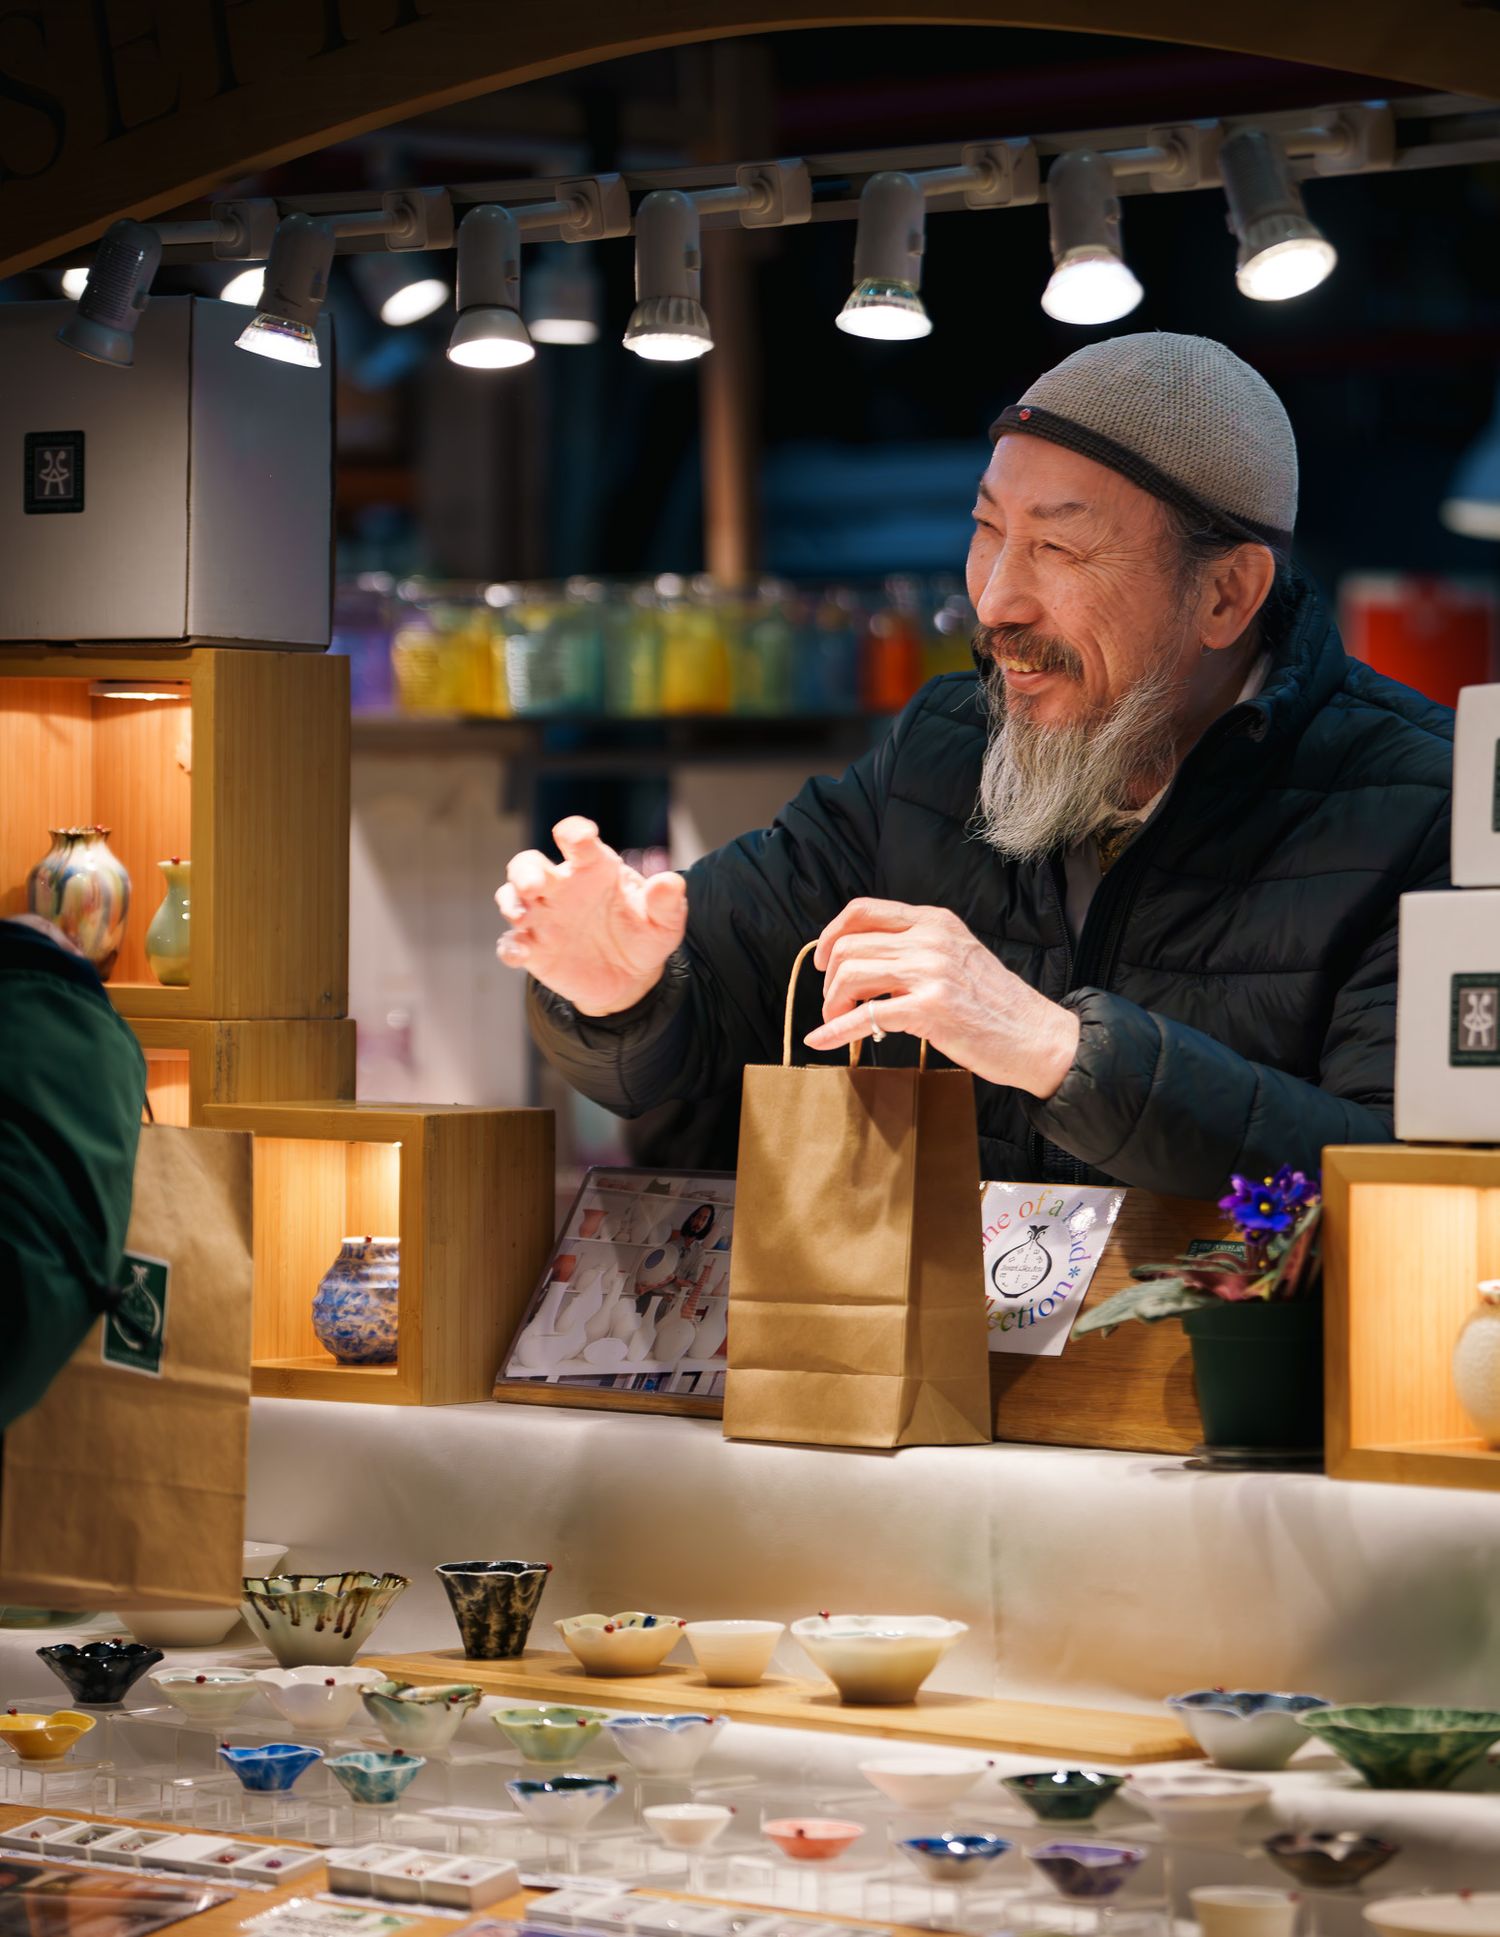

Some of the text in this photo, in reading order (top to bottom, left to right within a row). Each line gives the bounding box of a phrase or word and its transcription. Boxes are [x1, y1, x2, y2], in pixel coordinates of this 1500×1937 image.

[981, 1213, 1012, 1250] ne
[1019, 1189, 1053, 1218] of
[1048, 1199, 1064, 1217] a
[985, 1281, 1074, 1332] ection
